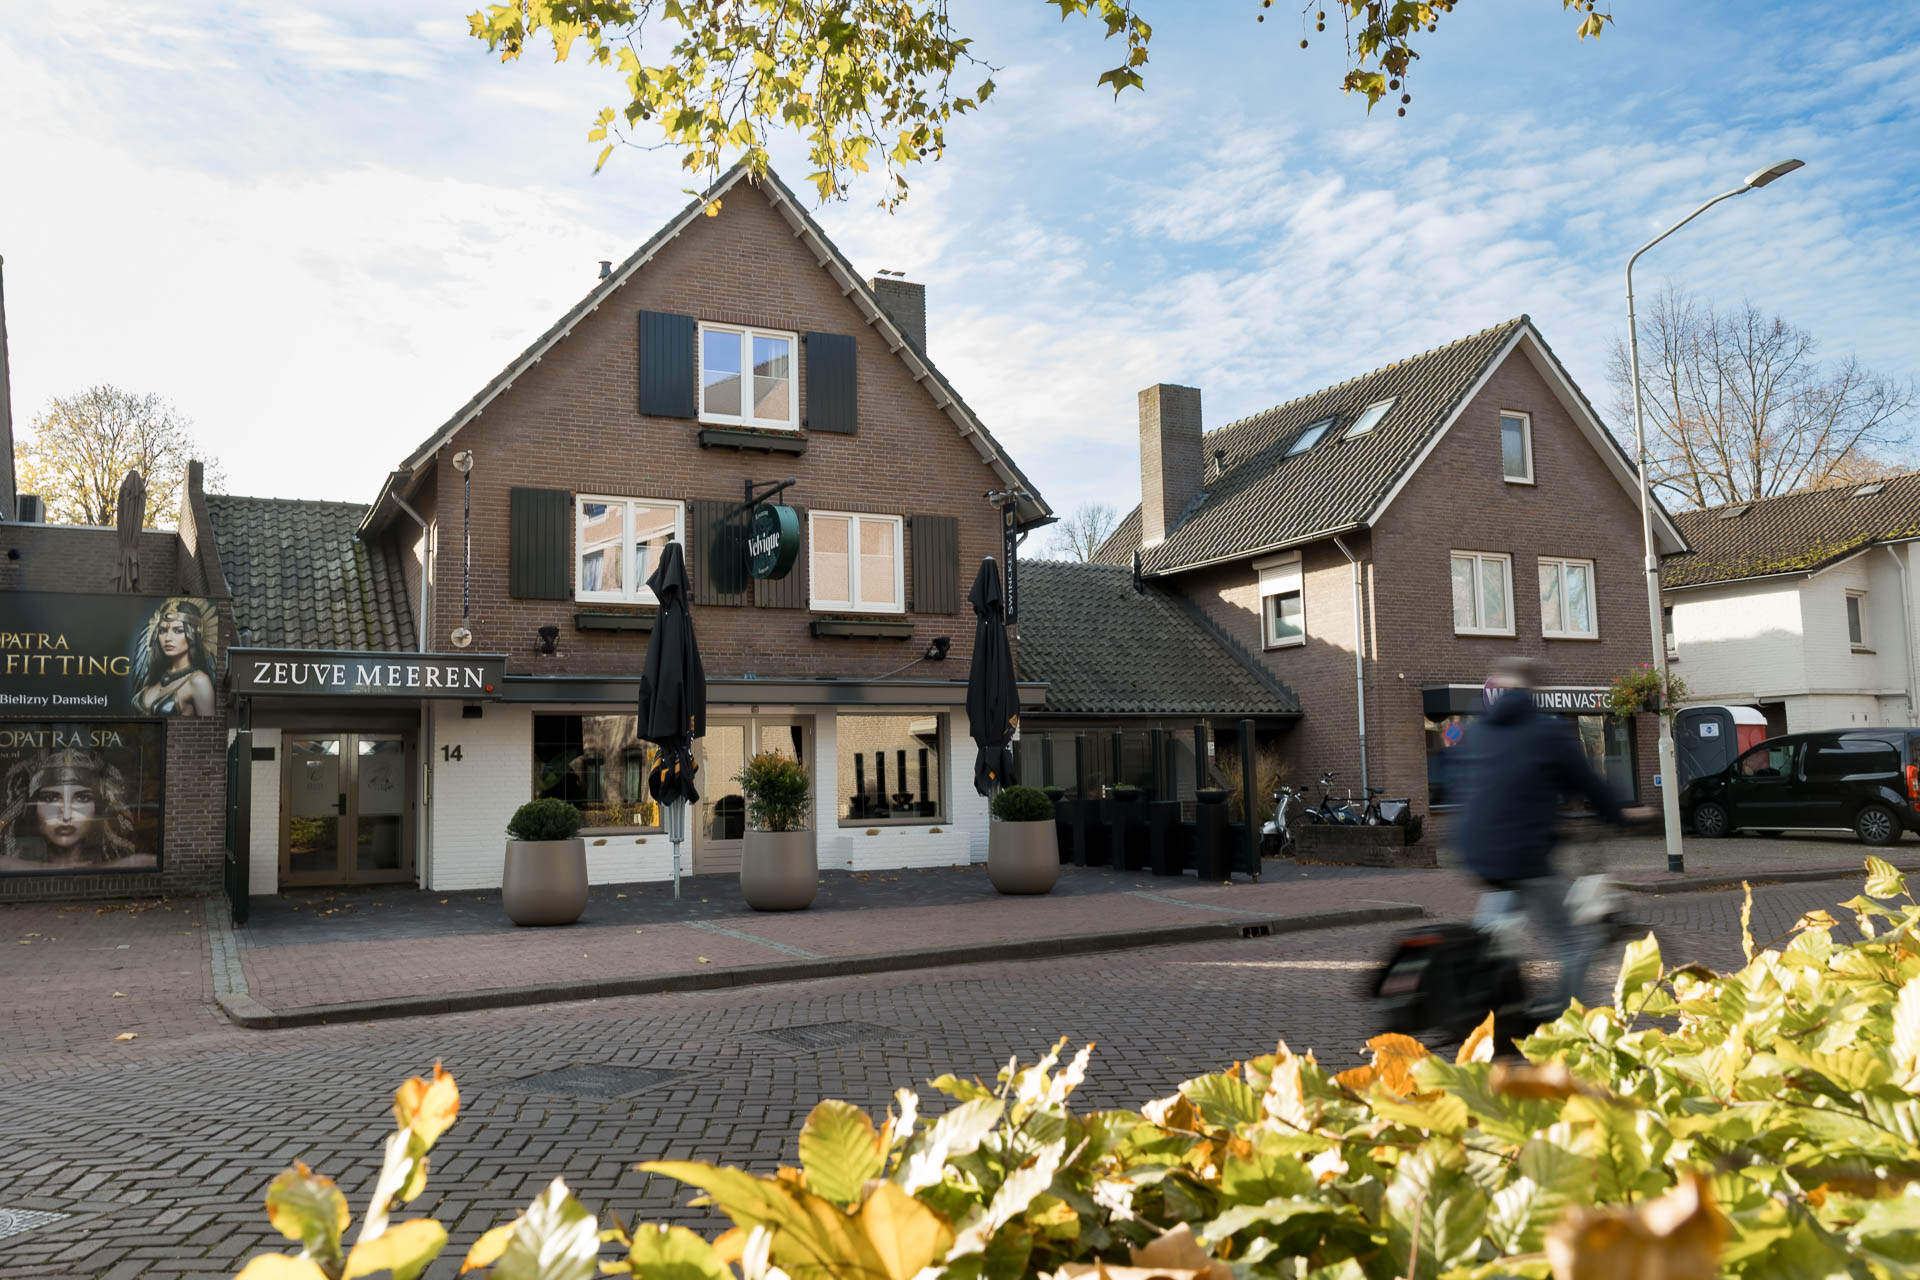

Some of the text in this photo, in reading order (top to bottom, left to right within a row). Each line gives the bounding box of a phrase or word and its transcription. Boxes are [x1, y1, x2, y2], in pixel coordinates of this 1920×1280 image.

[748, 532, 780, 557] Velvique
[0, 632, 70, 650] PATRA
[6, 654, 131, 676] FITTING
[253, 662, 484, 689] ZEUVE MEEREN
[0, 694, 108, 707] Bielizny Damskiej
[1531, 692, 1571, 708] IJNEN
[89, 730, 124, 748] SPA
[441, 744, 463, 761] 14
